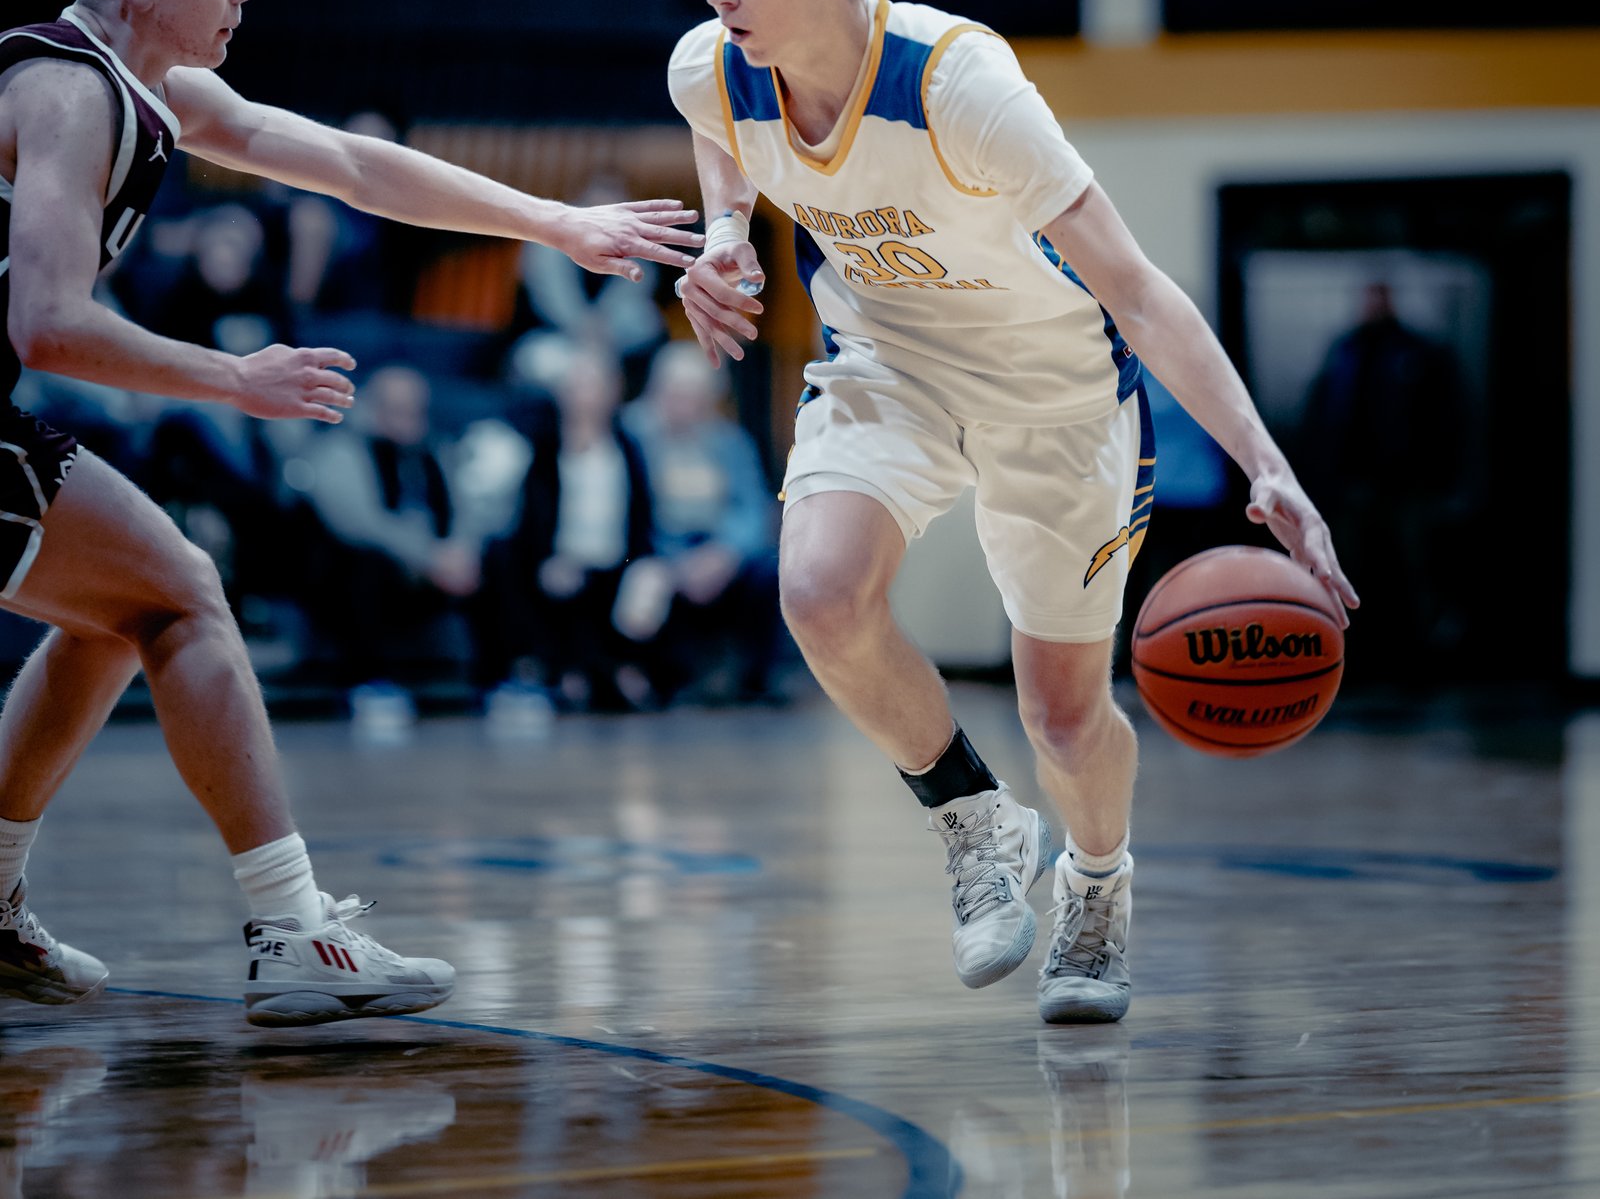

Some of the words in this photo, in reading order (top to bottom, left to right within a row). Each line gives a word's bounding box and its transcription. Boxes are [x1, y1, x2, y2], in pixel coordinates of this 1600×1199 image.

[793, 203, 935, 239] AURORA
[833, 240, 948, 282] 30
[1184, 622, 1322, 665] Wilson
[1187, 693, 1319, 727] EVOLUTION
